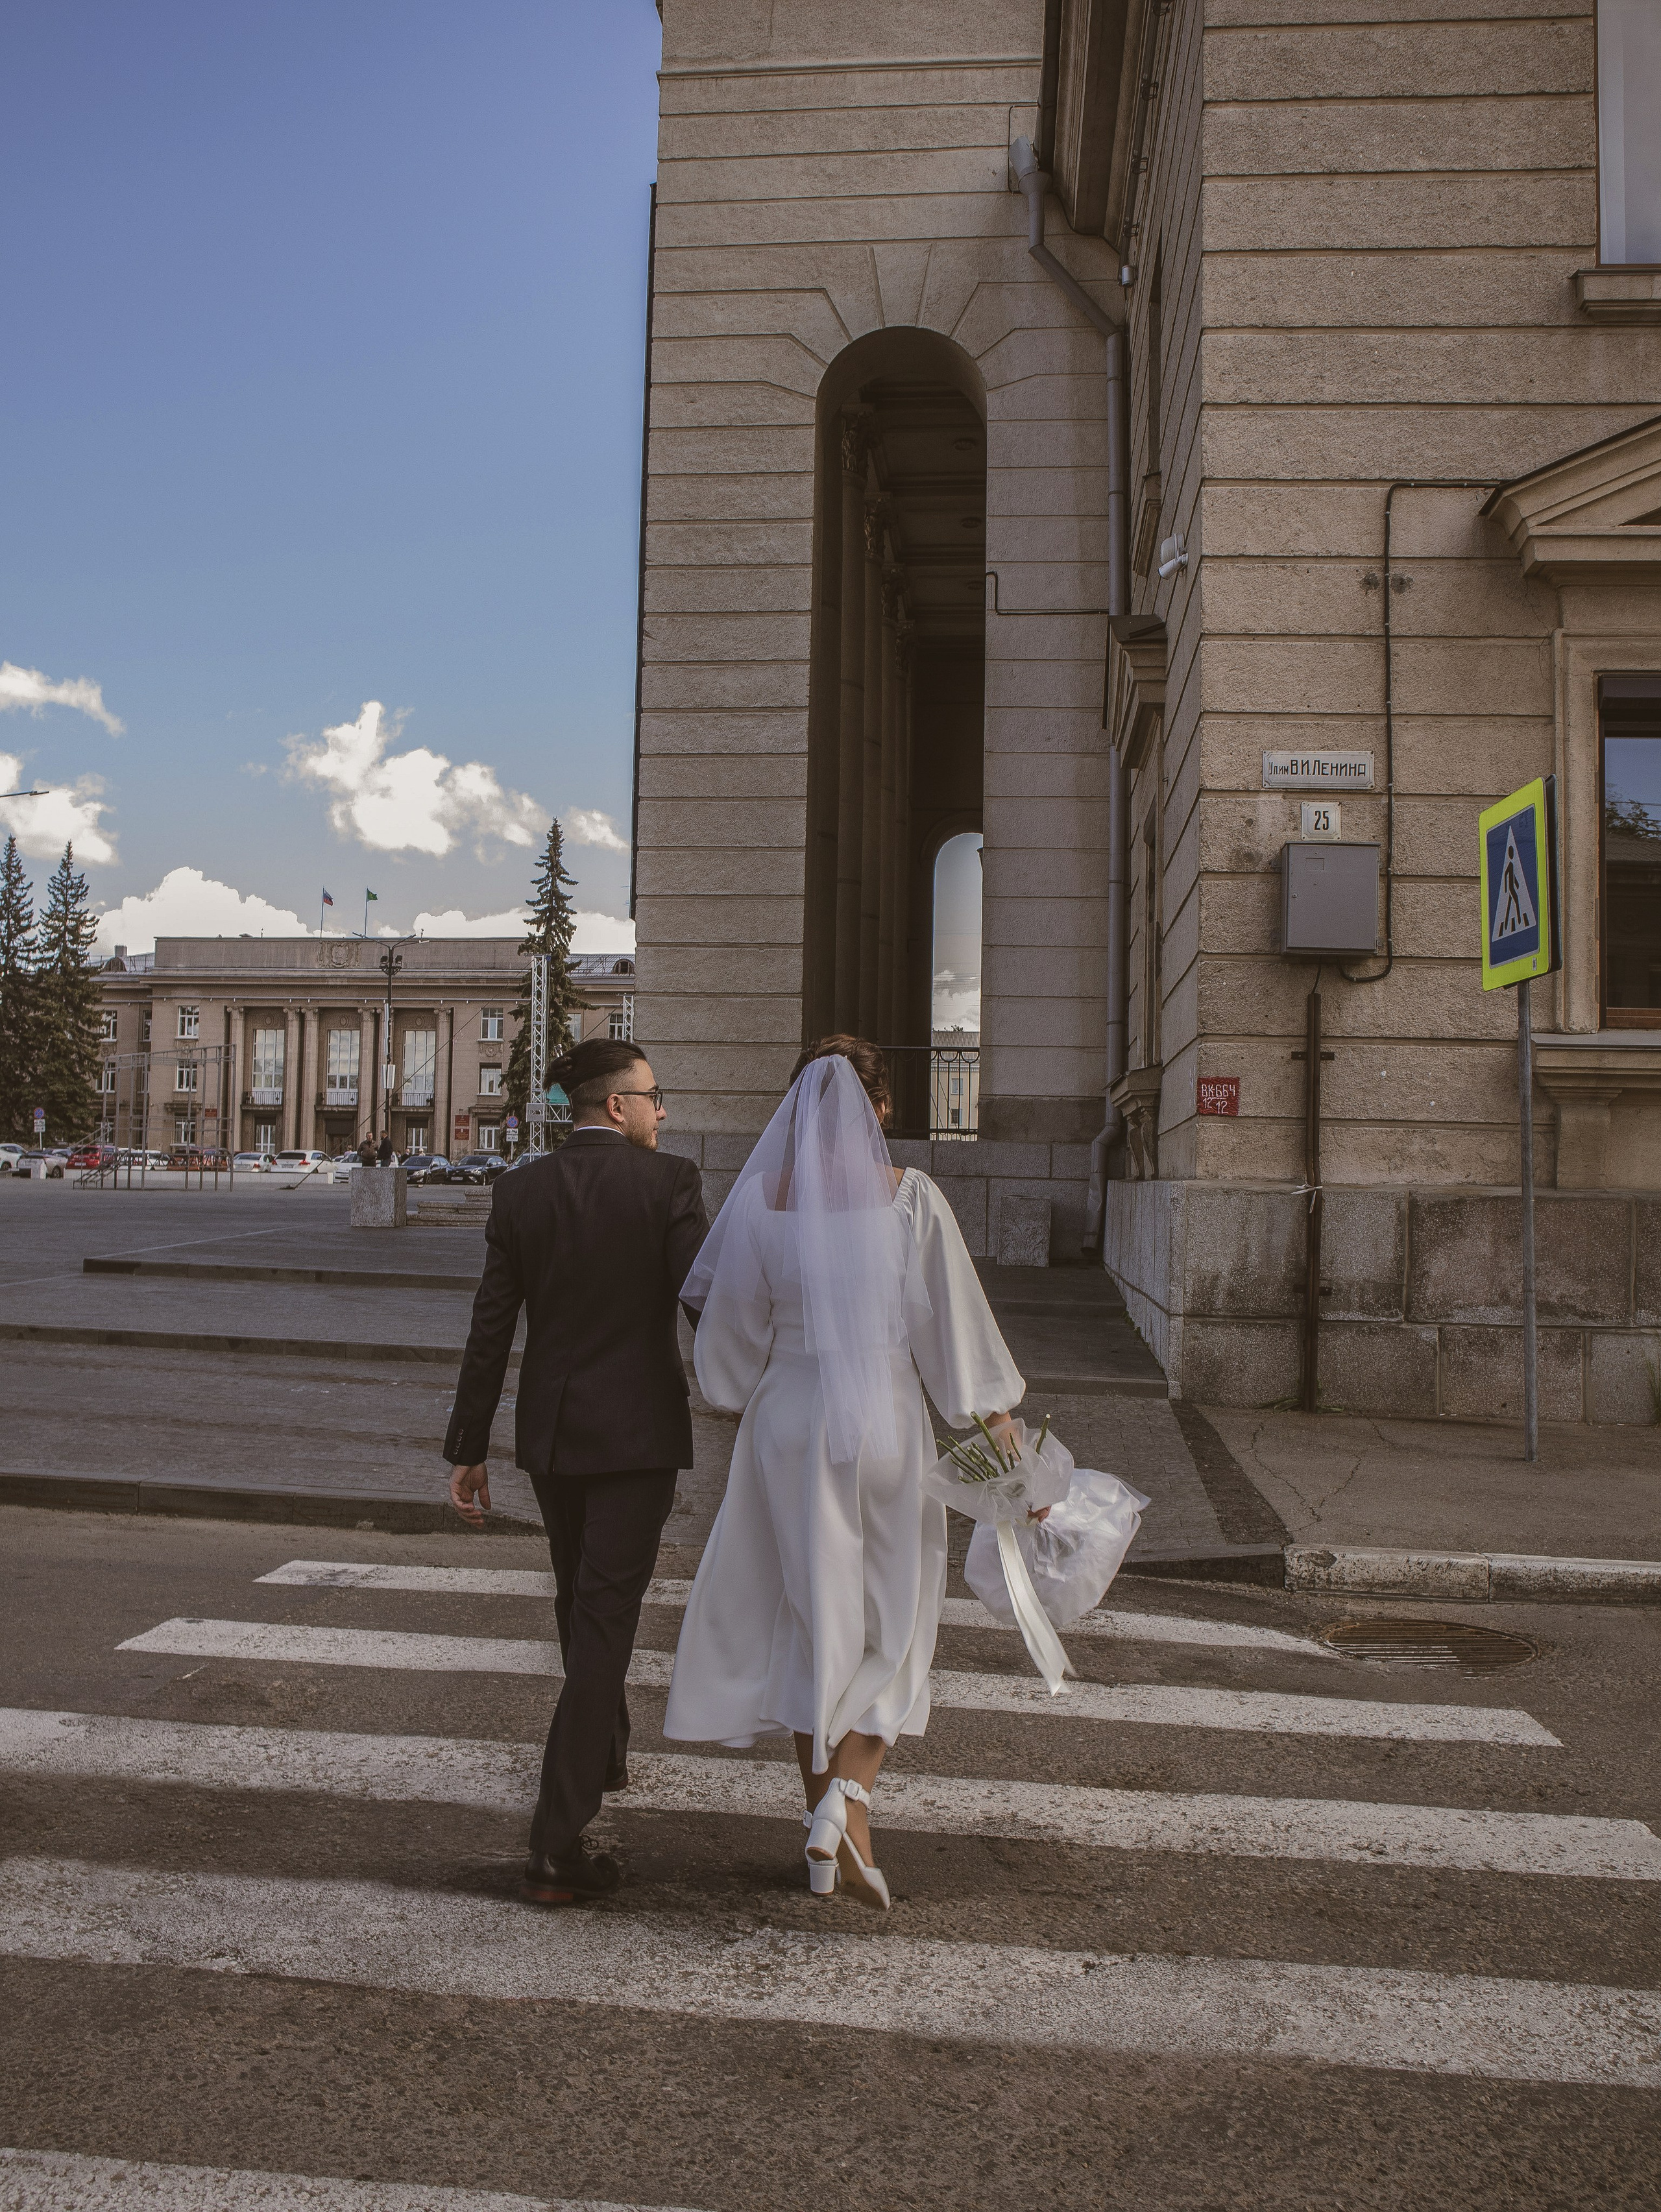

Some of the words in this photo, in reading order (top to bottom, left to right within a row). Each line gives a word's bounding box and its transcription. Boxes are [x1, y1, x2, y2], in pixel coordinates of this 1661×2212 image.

[1314, 810, 1329, 830] 25
[1202, 1097, 1212, 1109] 12
[1216, 1100, 1228, 1114] 12
